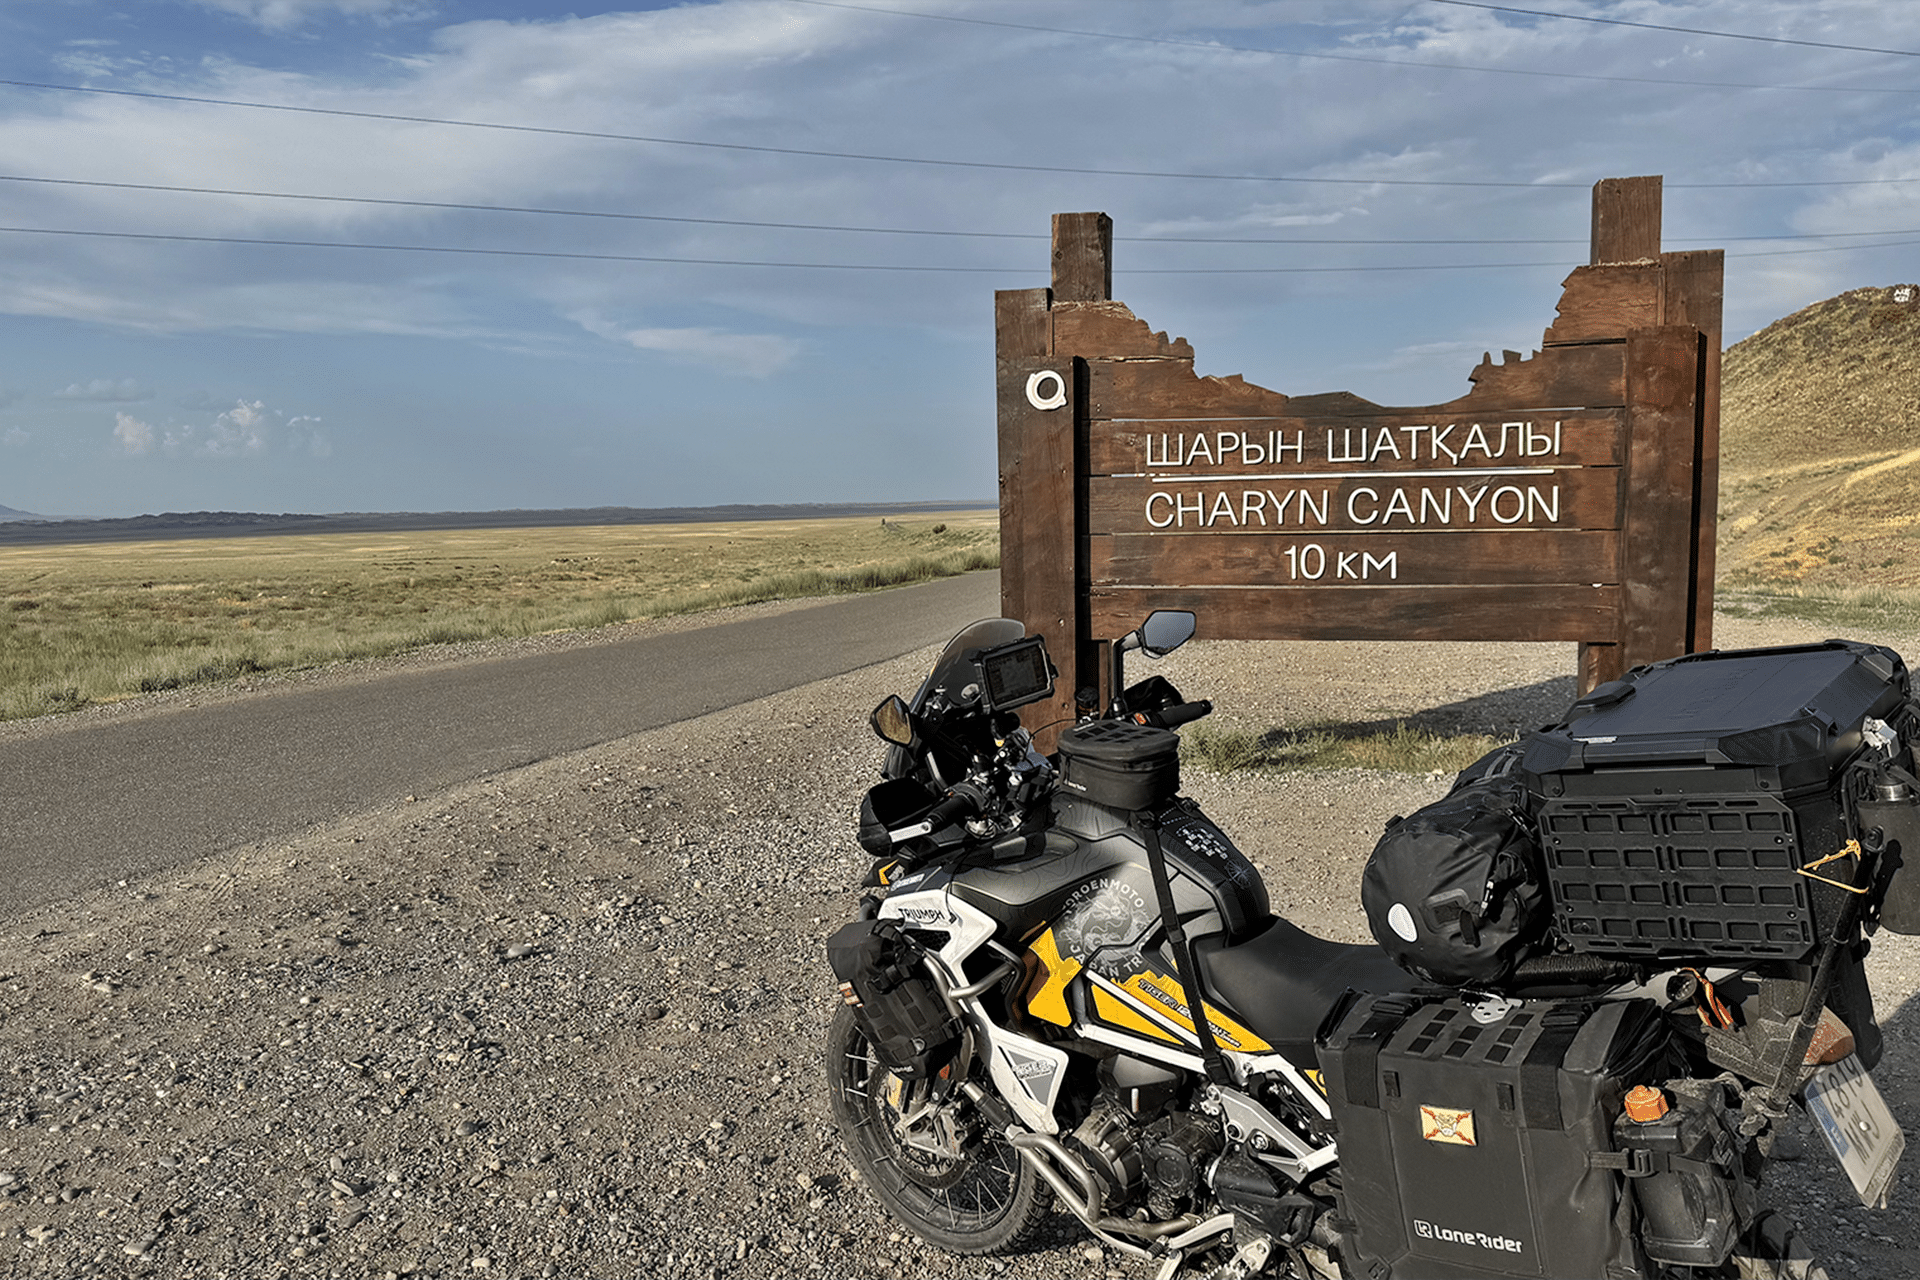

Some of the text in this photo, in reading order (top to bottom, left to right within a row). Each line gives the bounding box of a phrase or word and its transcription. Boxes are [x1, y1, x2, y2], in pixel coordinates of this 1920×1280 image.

[1146, 421, 1562, 466] ШАРЫН ШАТҚАЛЫ
[1145, 485, 1560, 528] CHARYN CANYON
[1284, 543, 1326, 580] 10
[898, 908, 945, 924] TRIUMPH
[1821, 1057, 1864, 1119] 4819
